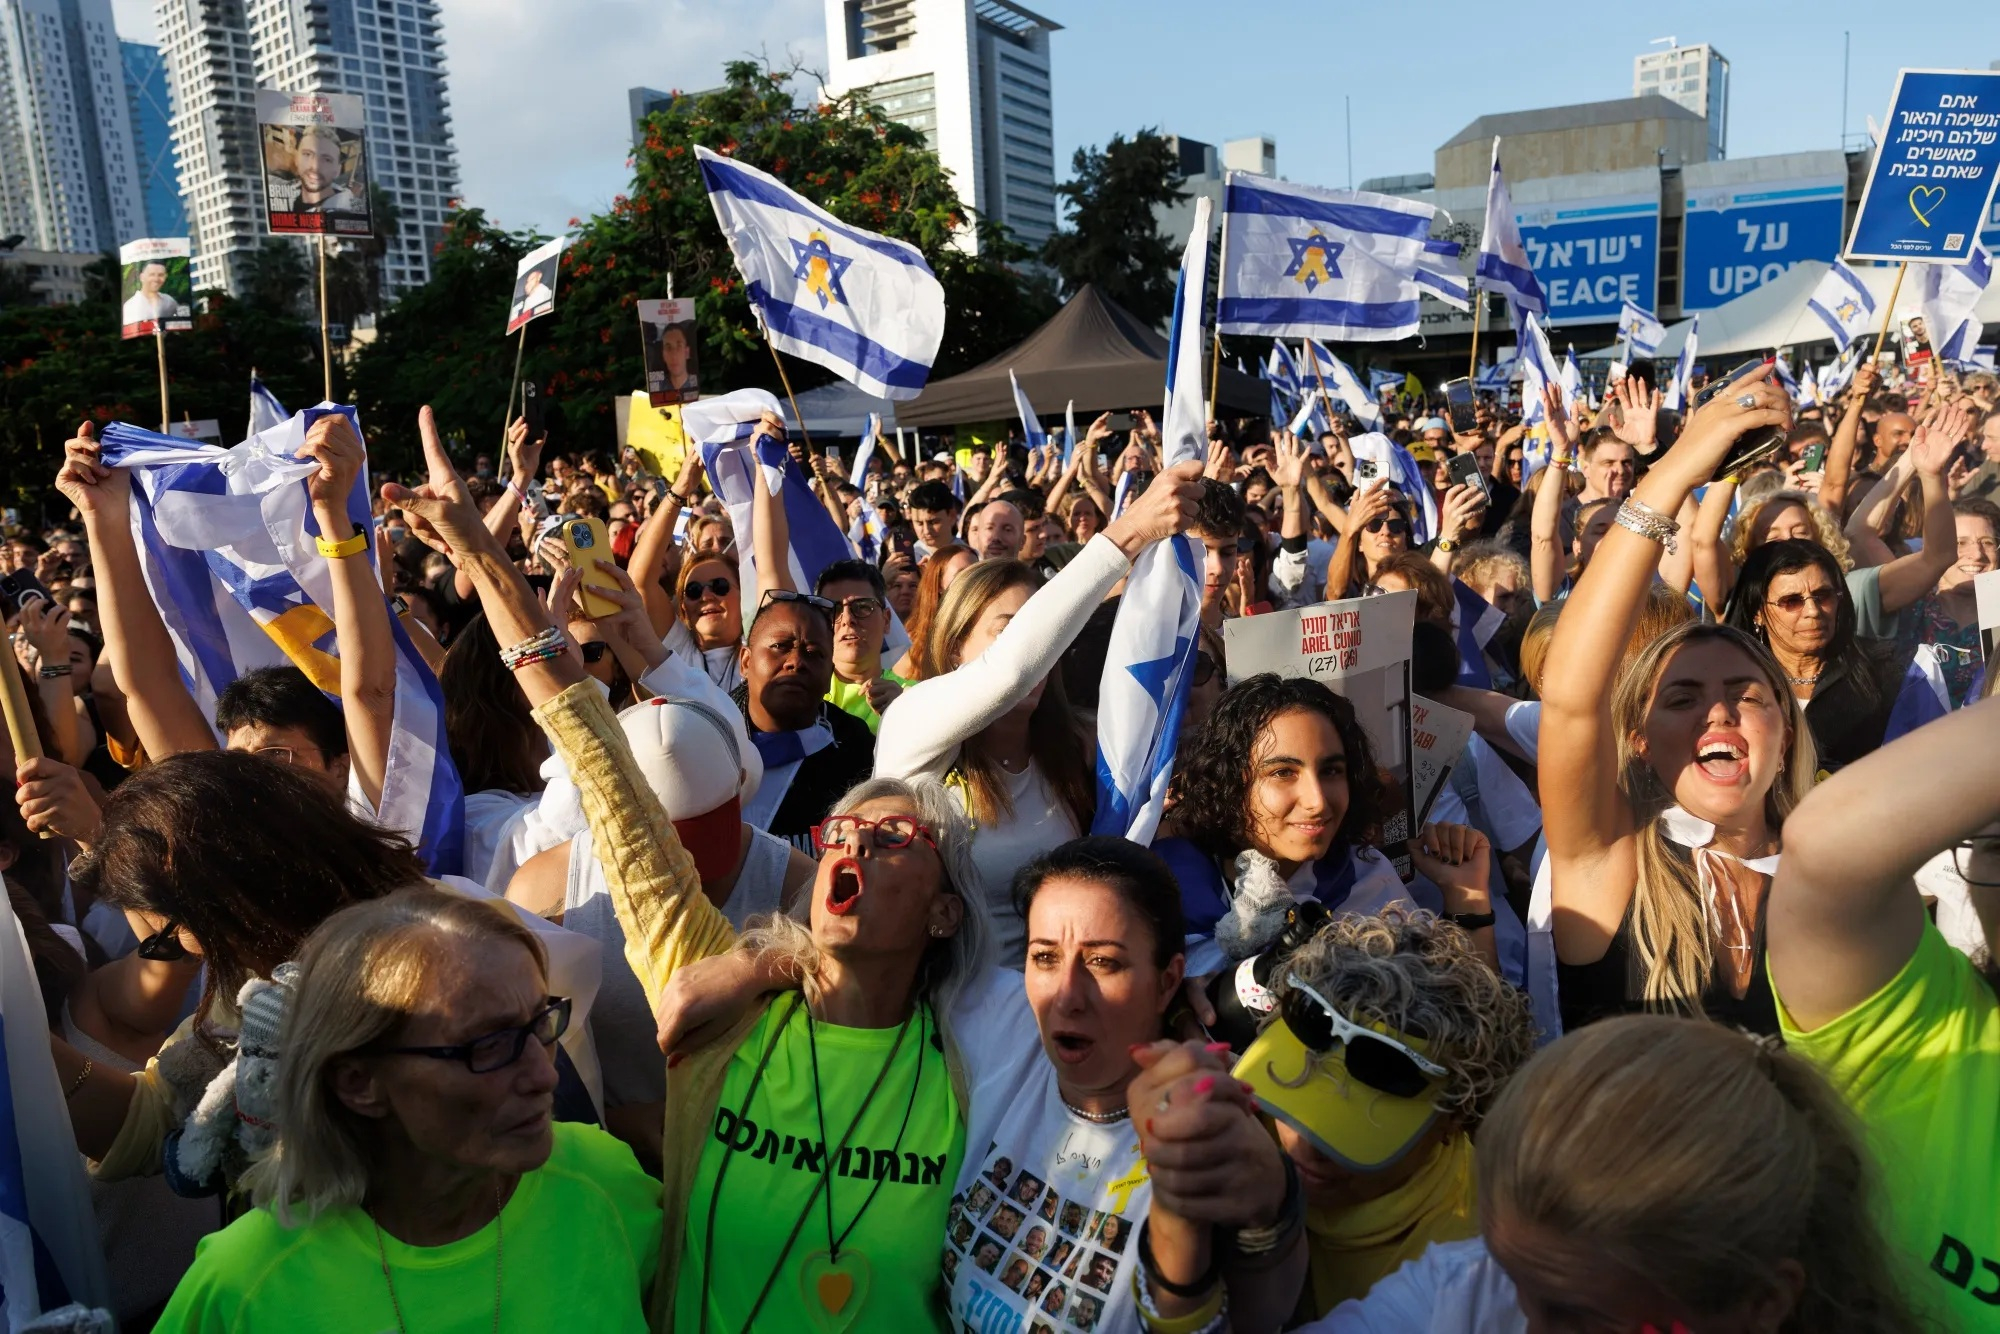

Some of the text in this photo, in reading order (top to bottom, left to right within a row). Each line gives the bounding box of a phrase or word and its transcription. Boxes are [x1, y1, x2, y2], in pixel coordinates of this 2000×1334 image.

[1939, 94, 1977, 108] אתם
[1900, 111, 1940, 126] והאור
[1896, 129, 1996, 145] שלהם חיכינו,
[1906, 147, 1977, 161] מאושרים
[1889, 163, 1983, 179] שאתם בבית
[1737, 219, 1789, 253] על
[1527, 234, 1642, 271] ישראל
[1709, 261, 1799, 295] UPO
[1540, 274, 1640, 308] EACE
[1301, 611, 1360, 635] אריאל קוניו
[1302, 629, 1362, 655] ARIEL CUNIO
[1308, 655, 1337, 676] (27)
[715, 1106, 947, 1185] איתכם אנחנו
